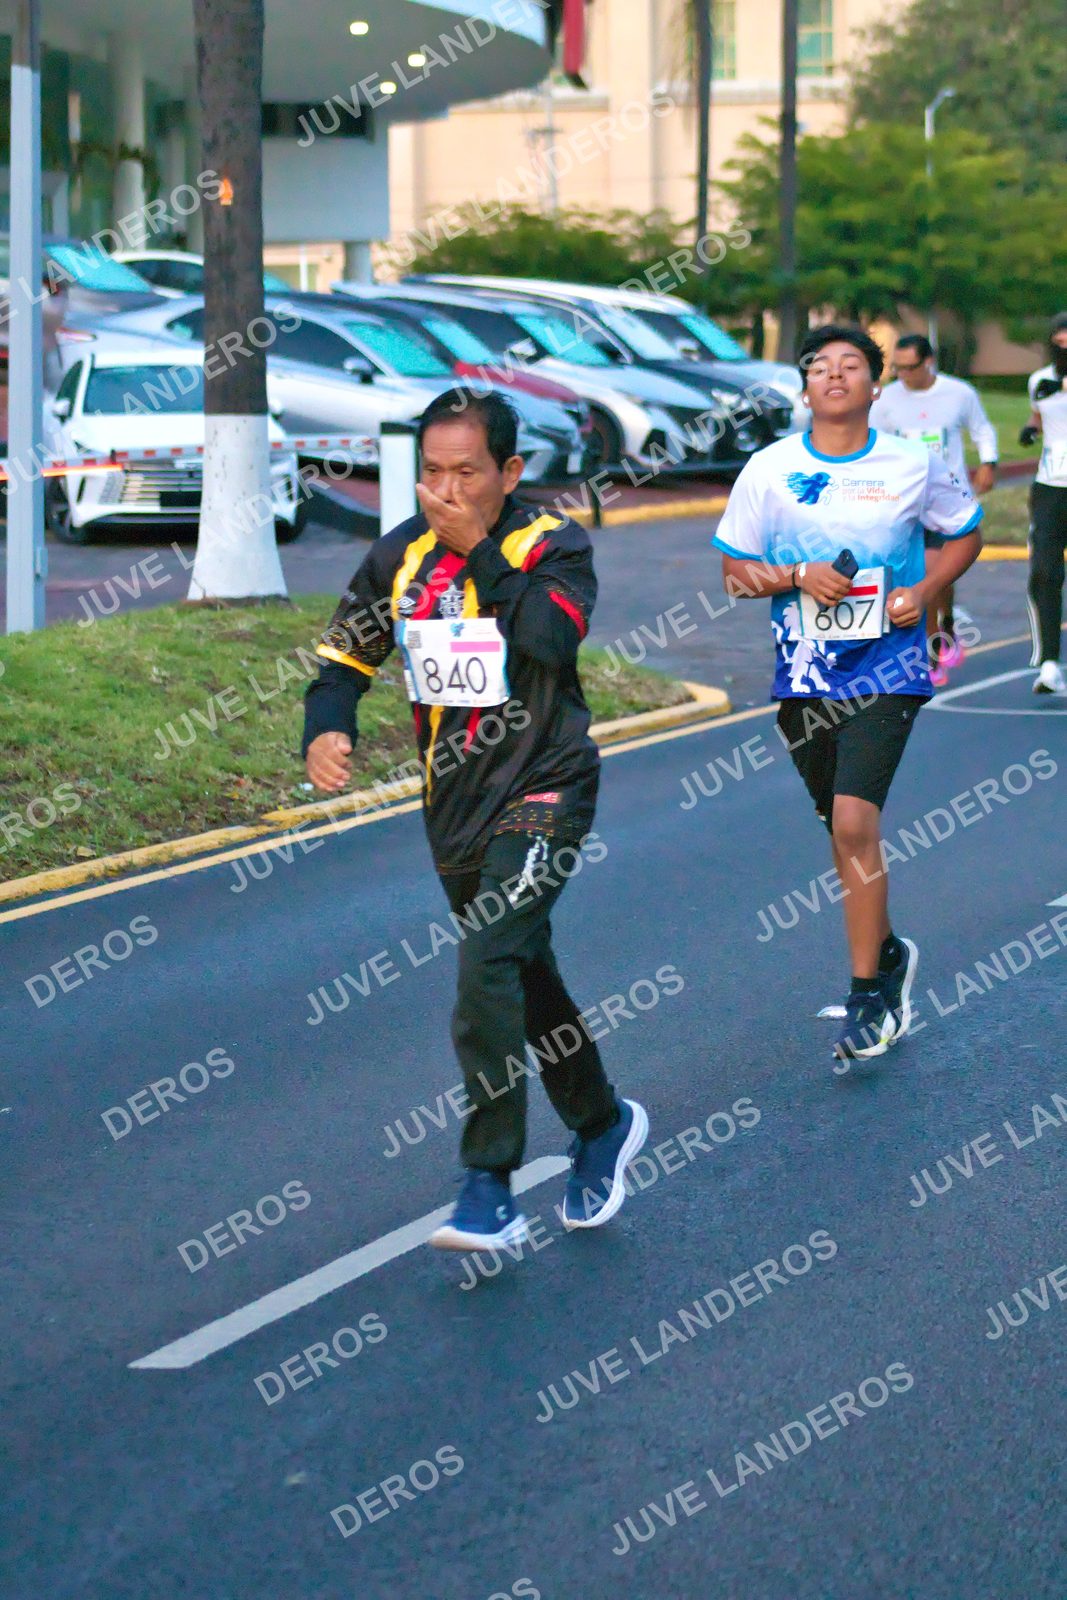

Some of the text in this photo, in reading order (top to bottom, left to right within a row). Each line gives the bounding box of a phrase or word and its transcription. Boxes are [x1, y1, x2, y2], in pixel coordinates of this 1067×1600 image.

[842, 478, 884, 487] Carrera
[866, 487, 886, 495] Vida
[815, 598, 876, 631] 607
[423, 656, 487, 695] 840
